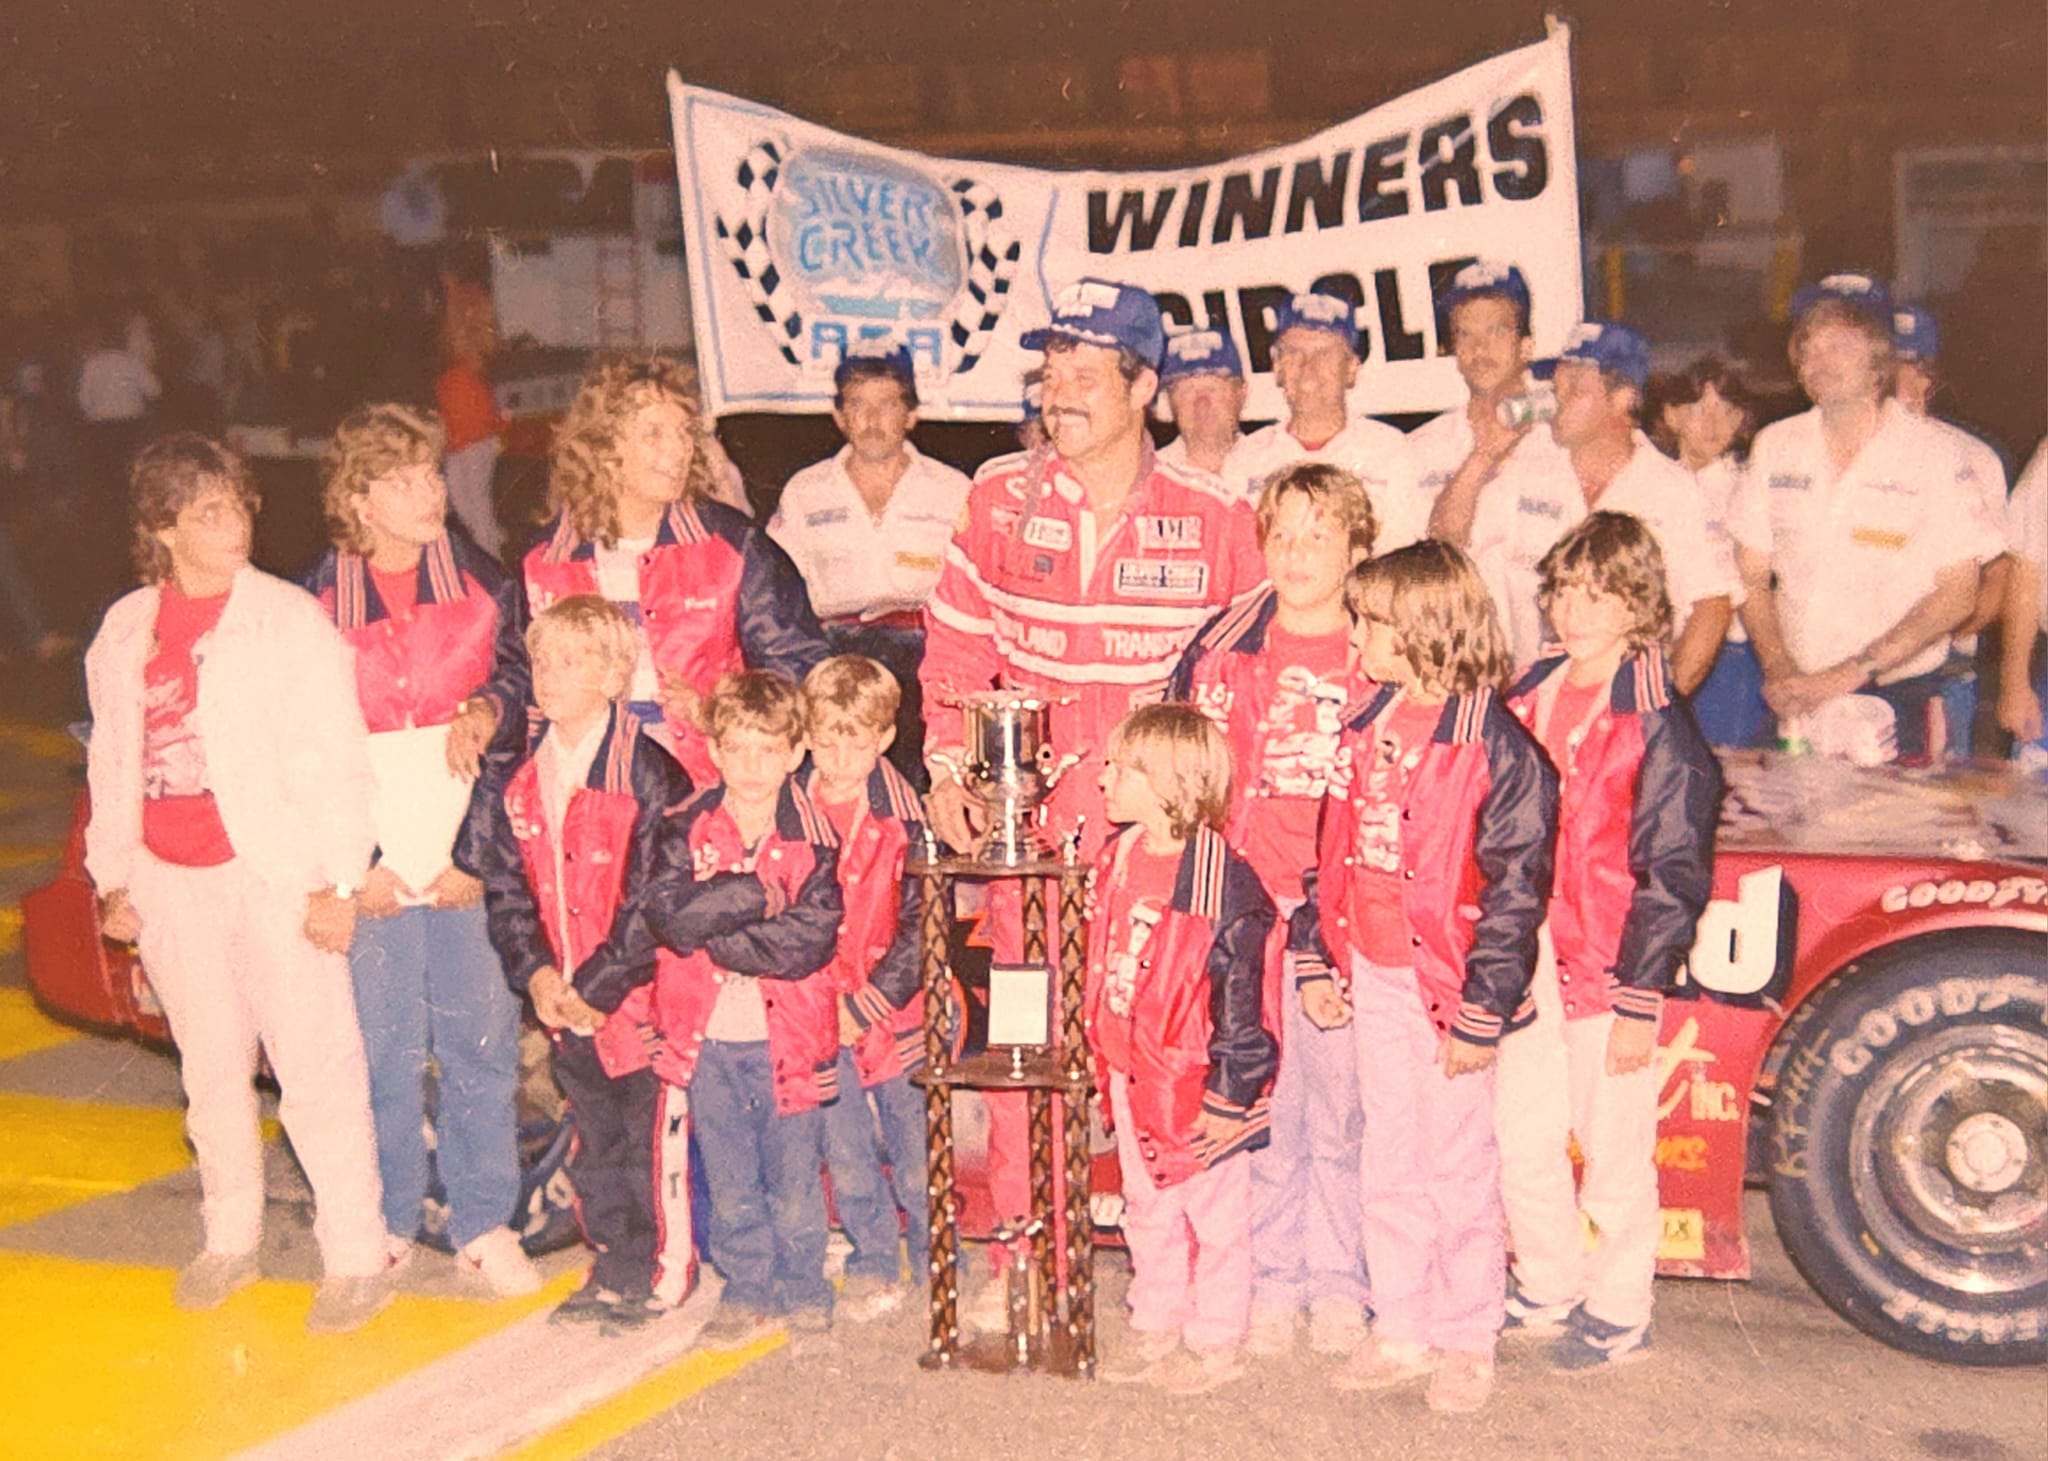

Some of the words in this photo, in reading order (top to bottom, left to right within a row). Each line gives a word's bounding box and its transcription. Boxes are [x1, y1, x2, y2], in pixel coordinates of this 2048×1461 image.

[1088, 93, 1548, 254] WINNERS
[794, 174, 932, 230] SILVER
[799, 220, 947, 273] CREEK
[1880, 875, 2048, 914] GOODY
